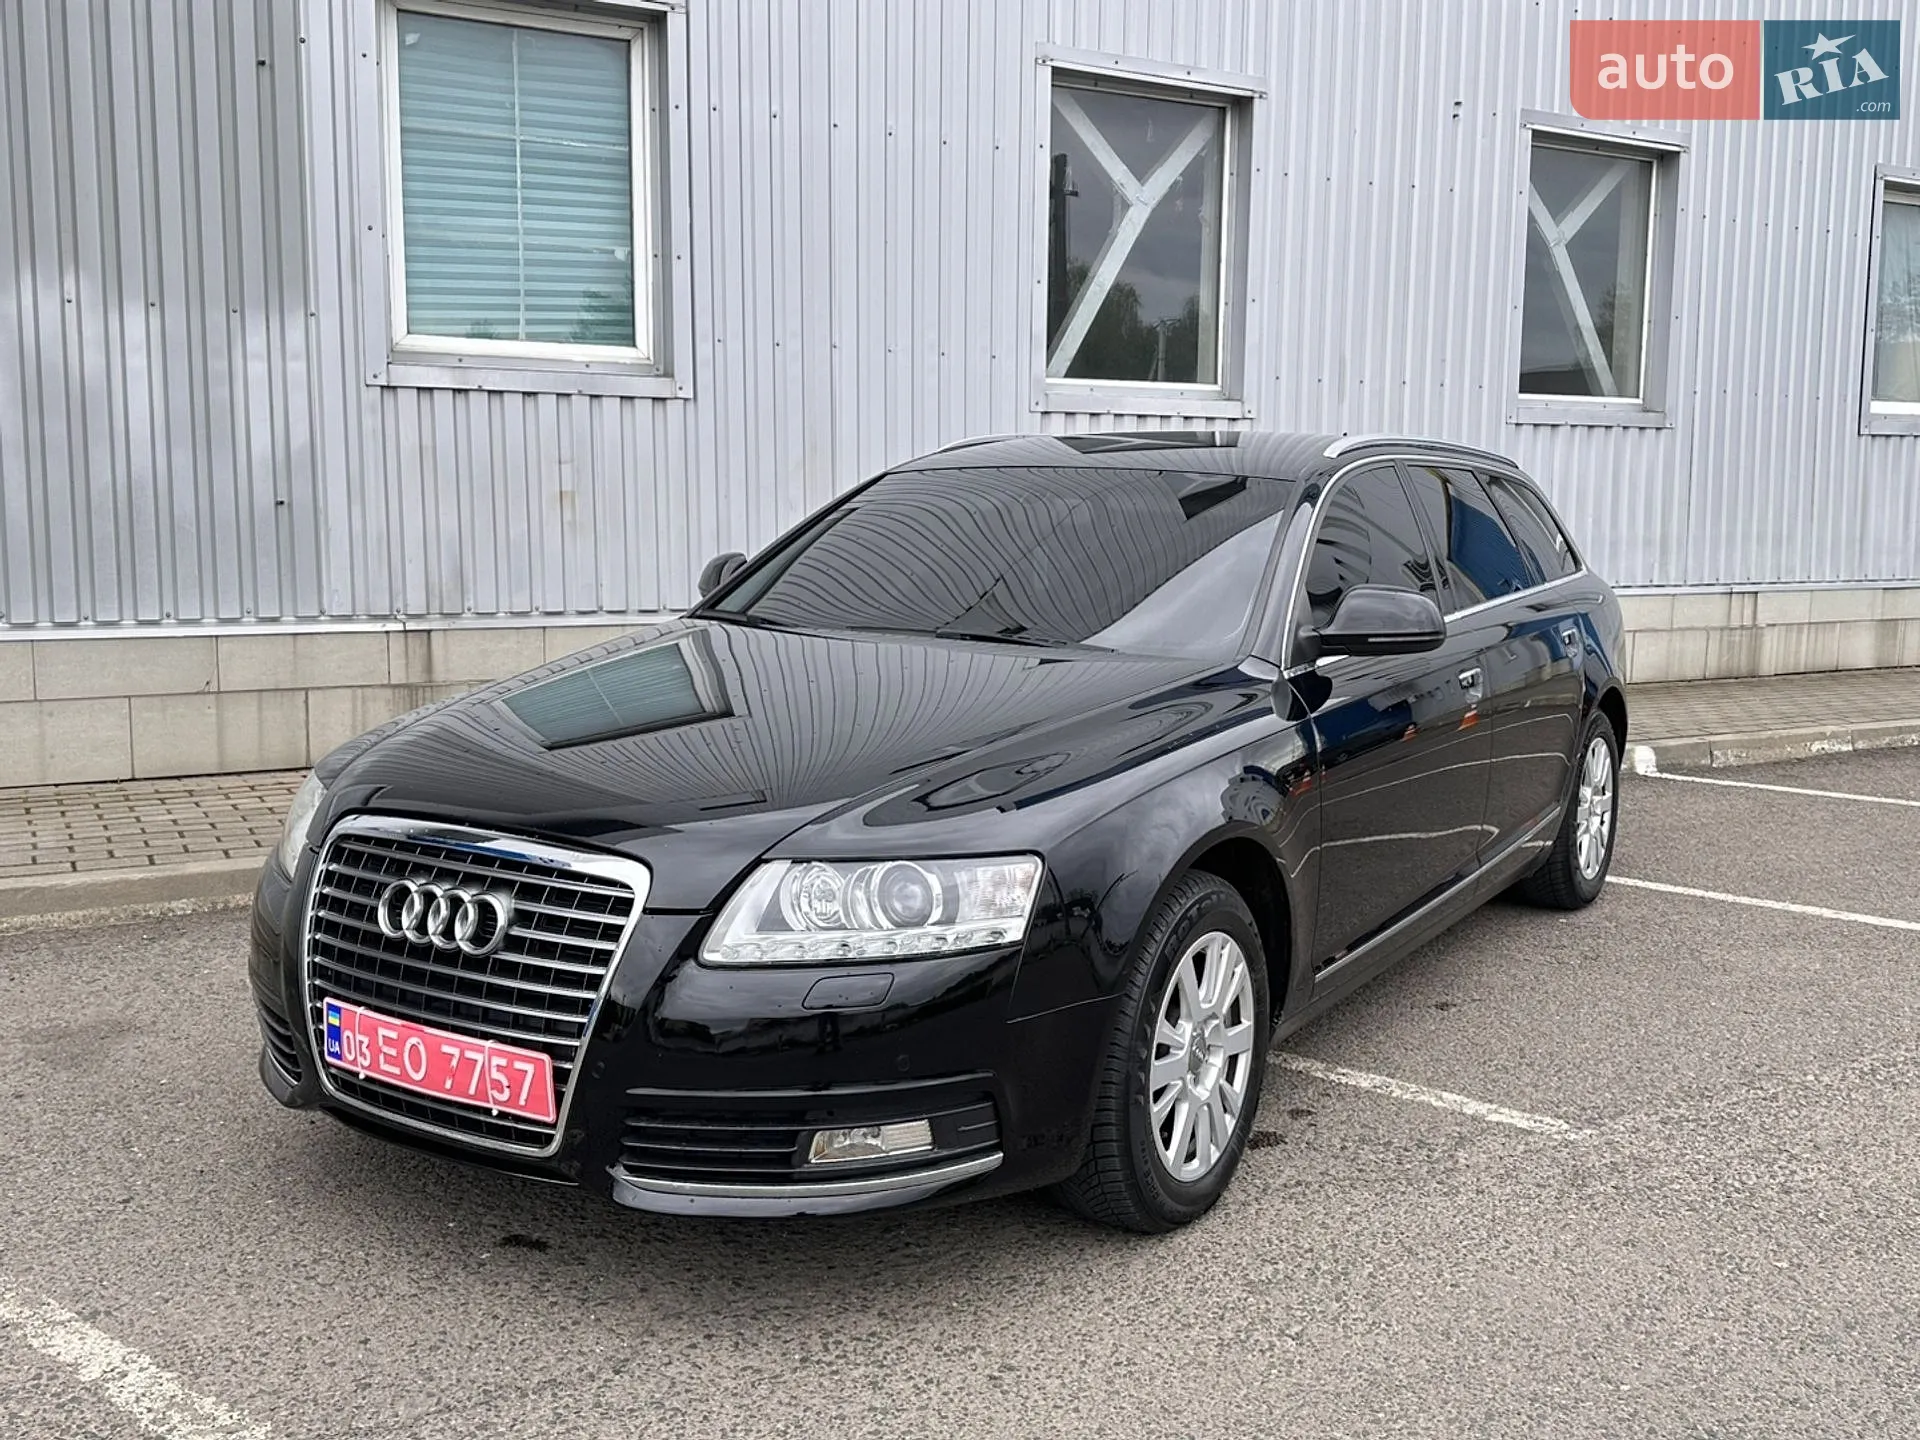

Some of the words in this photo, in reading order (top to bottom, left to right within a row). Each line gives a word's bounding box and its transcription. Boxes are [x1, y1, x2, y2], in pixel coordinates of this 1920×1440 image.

[327, 1037, 341, 1055] UA
[342, 1029, 371, 1068] 03
[377, 1026, 428, 1082] EO
[440, 1045, 536, 1107] 7757
